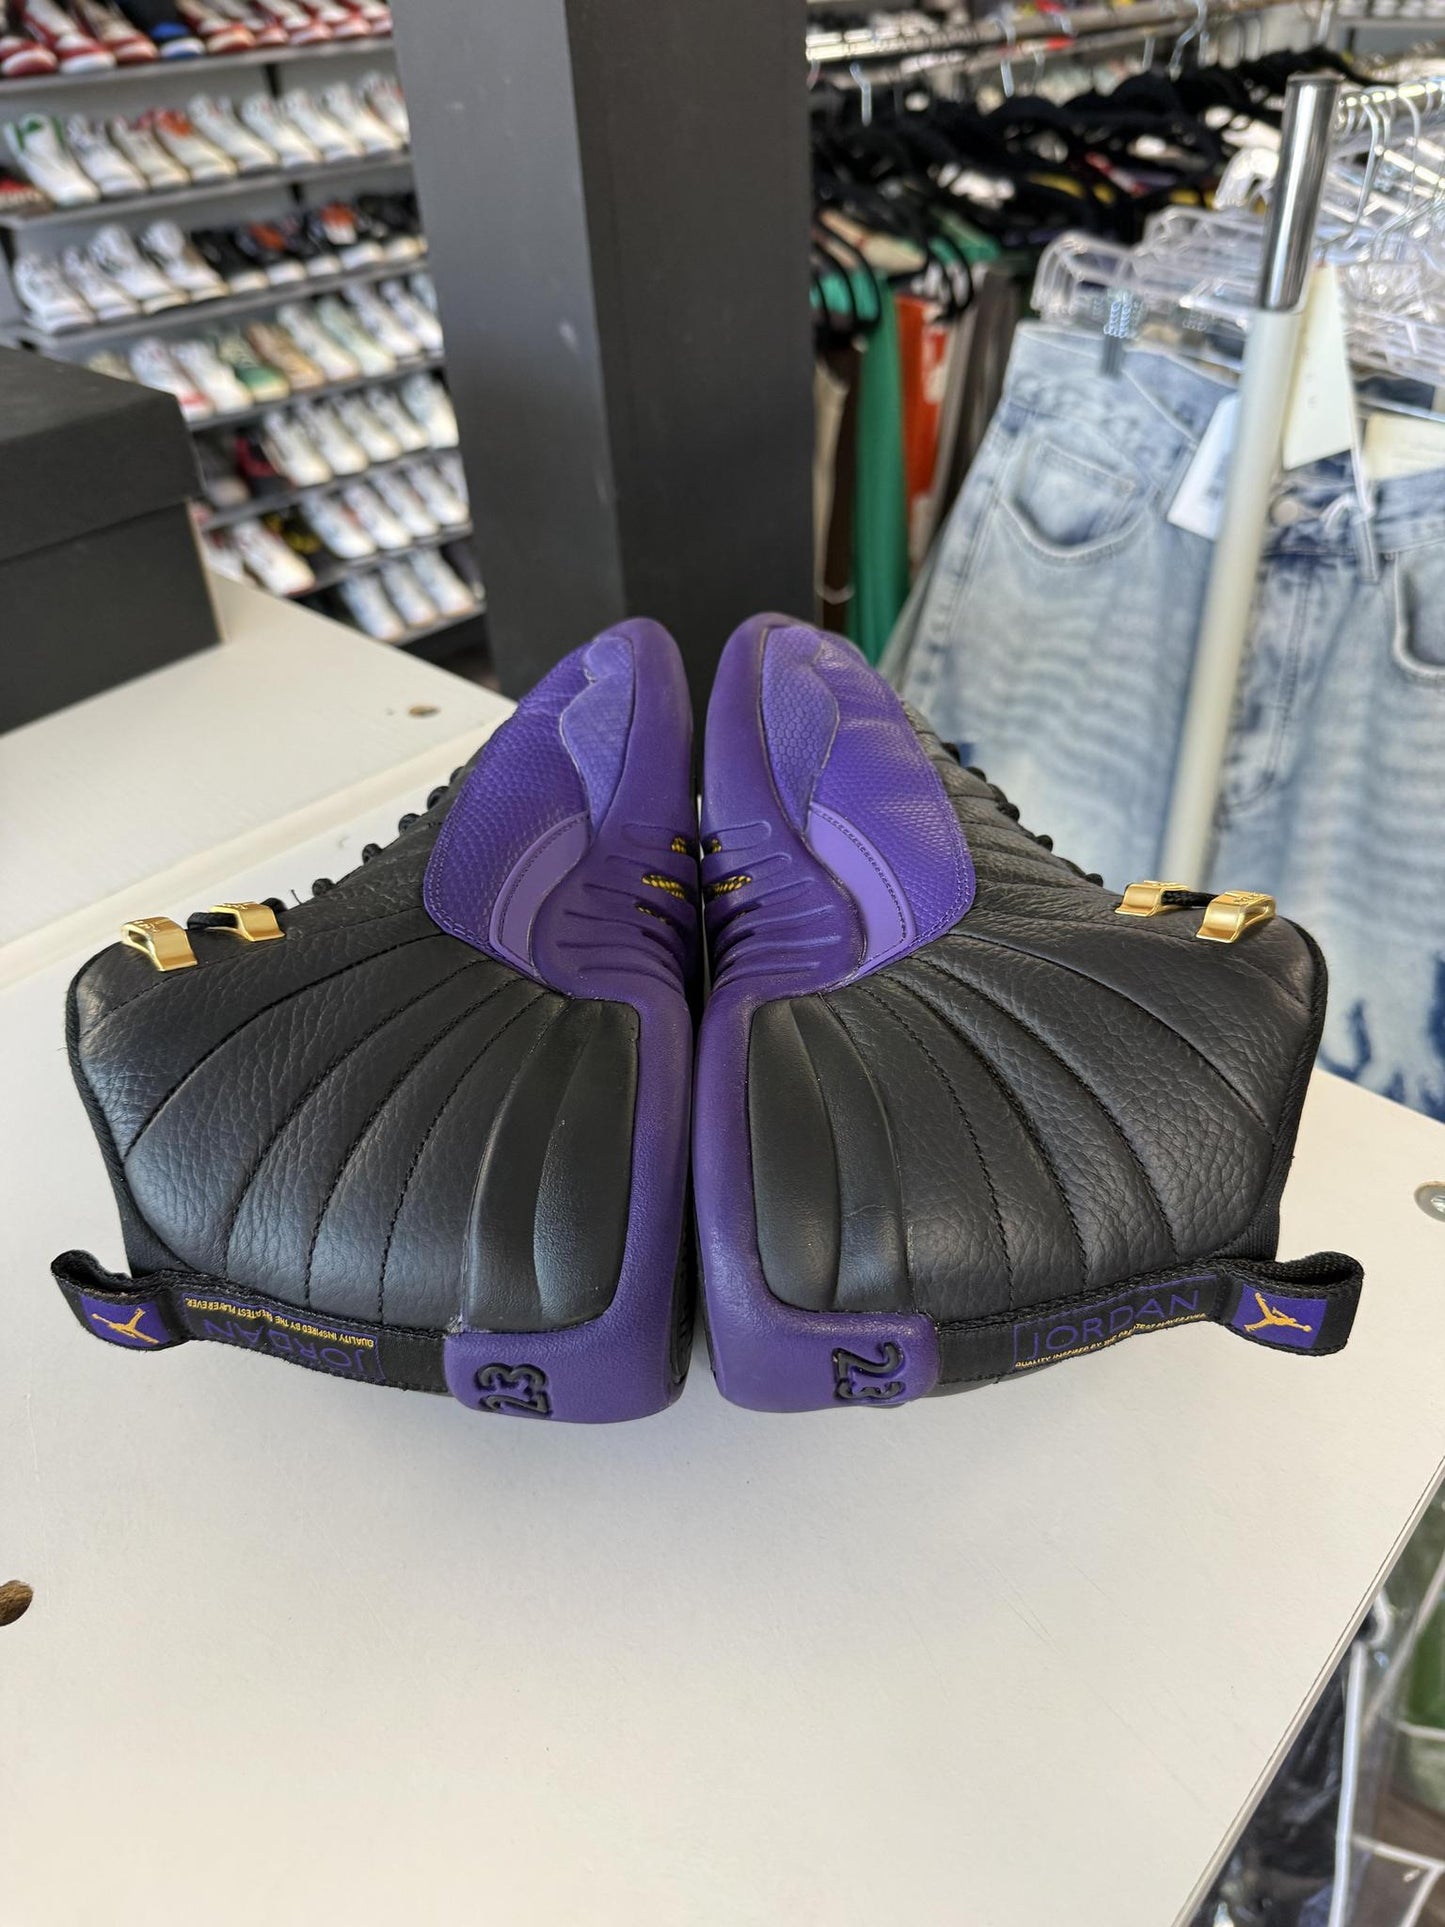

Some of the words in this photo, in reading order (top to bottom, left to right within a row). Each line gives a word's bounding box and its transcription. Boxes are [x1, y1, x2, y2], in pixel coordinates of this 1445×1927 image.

[208, 1301, 236, 1314] PLAYER
[275, 1315, 289, 1327] THE
[290, 1322, 301, 1331] BY
[1026, 1289, 1199, 1361] JORDAN
[302, 1324, 338, 1341] INSPIRED
[203, 1319, 364, 1372] JORDAN
[338, 1333, 374, 1348] QUALITY
[1015, 1356, 1051, 1368] QUALITY
[832, 1342, 905, 1400] 23
